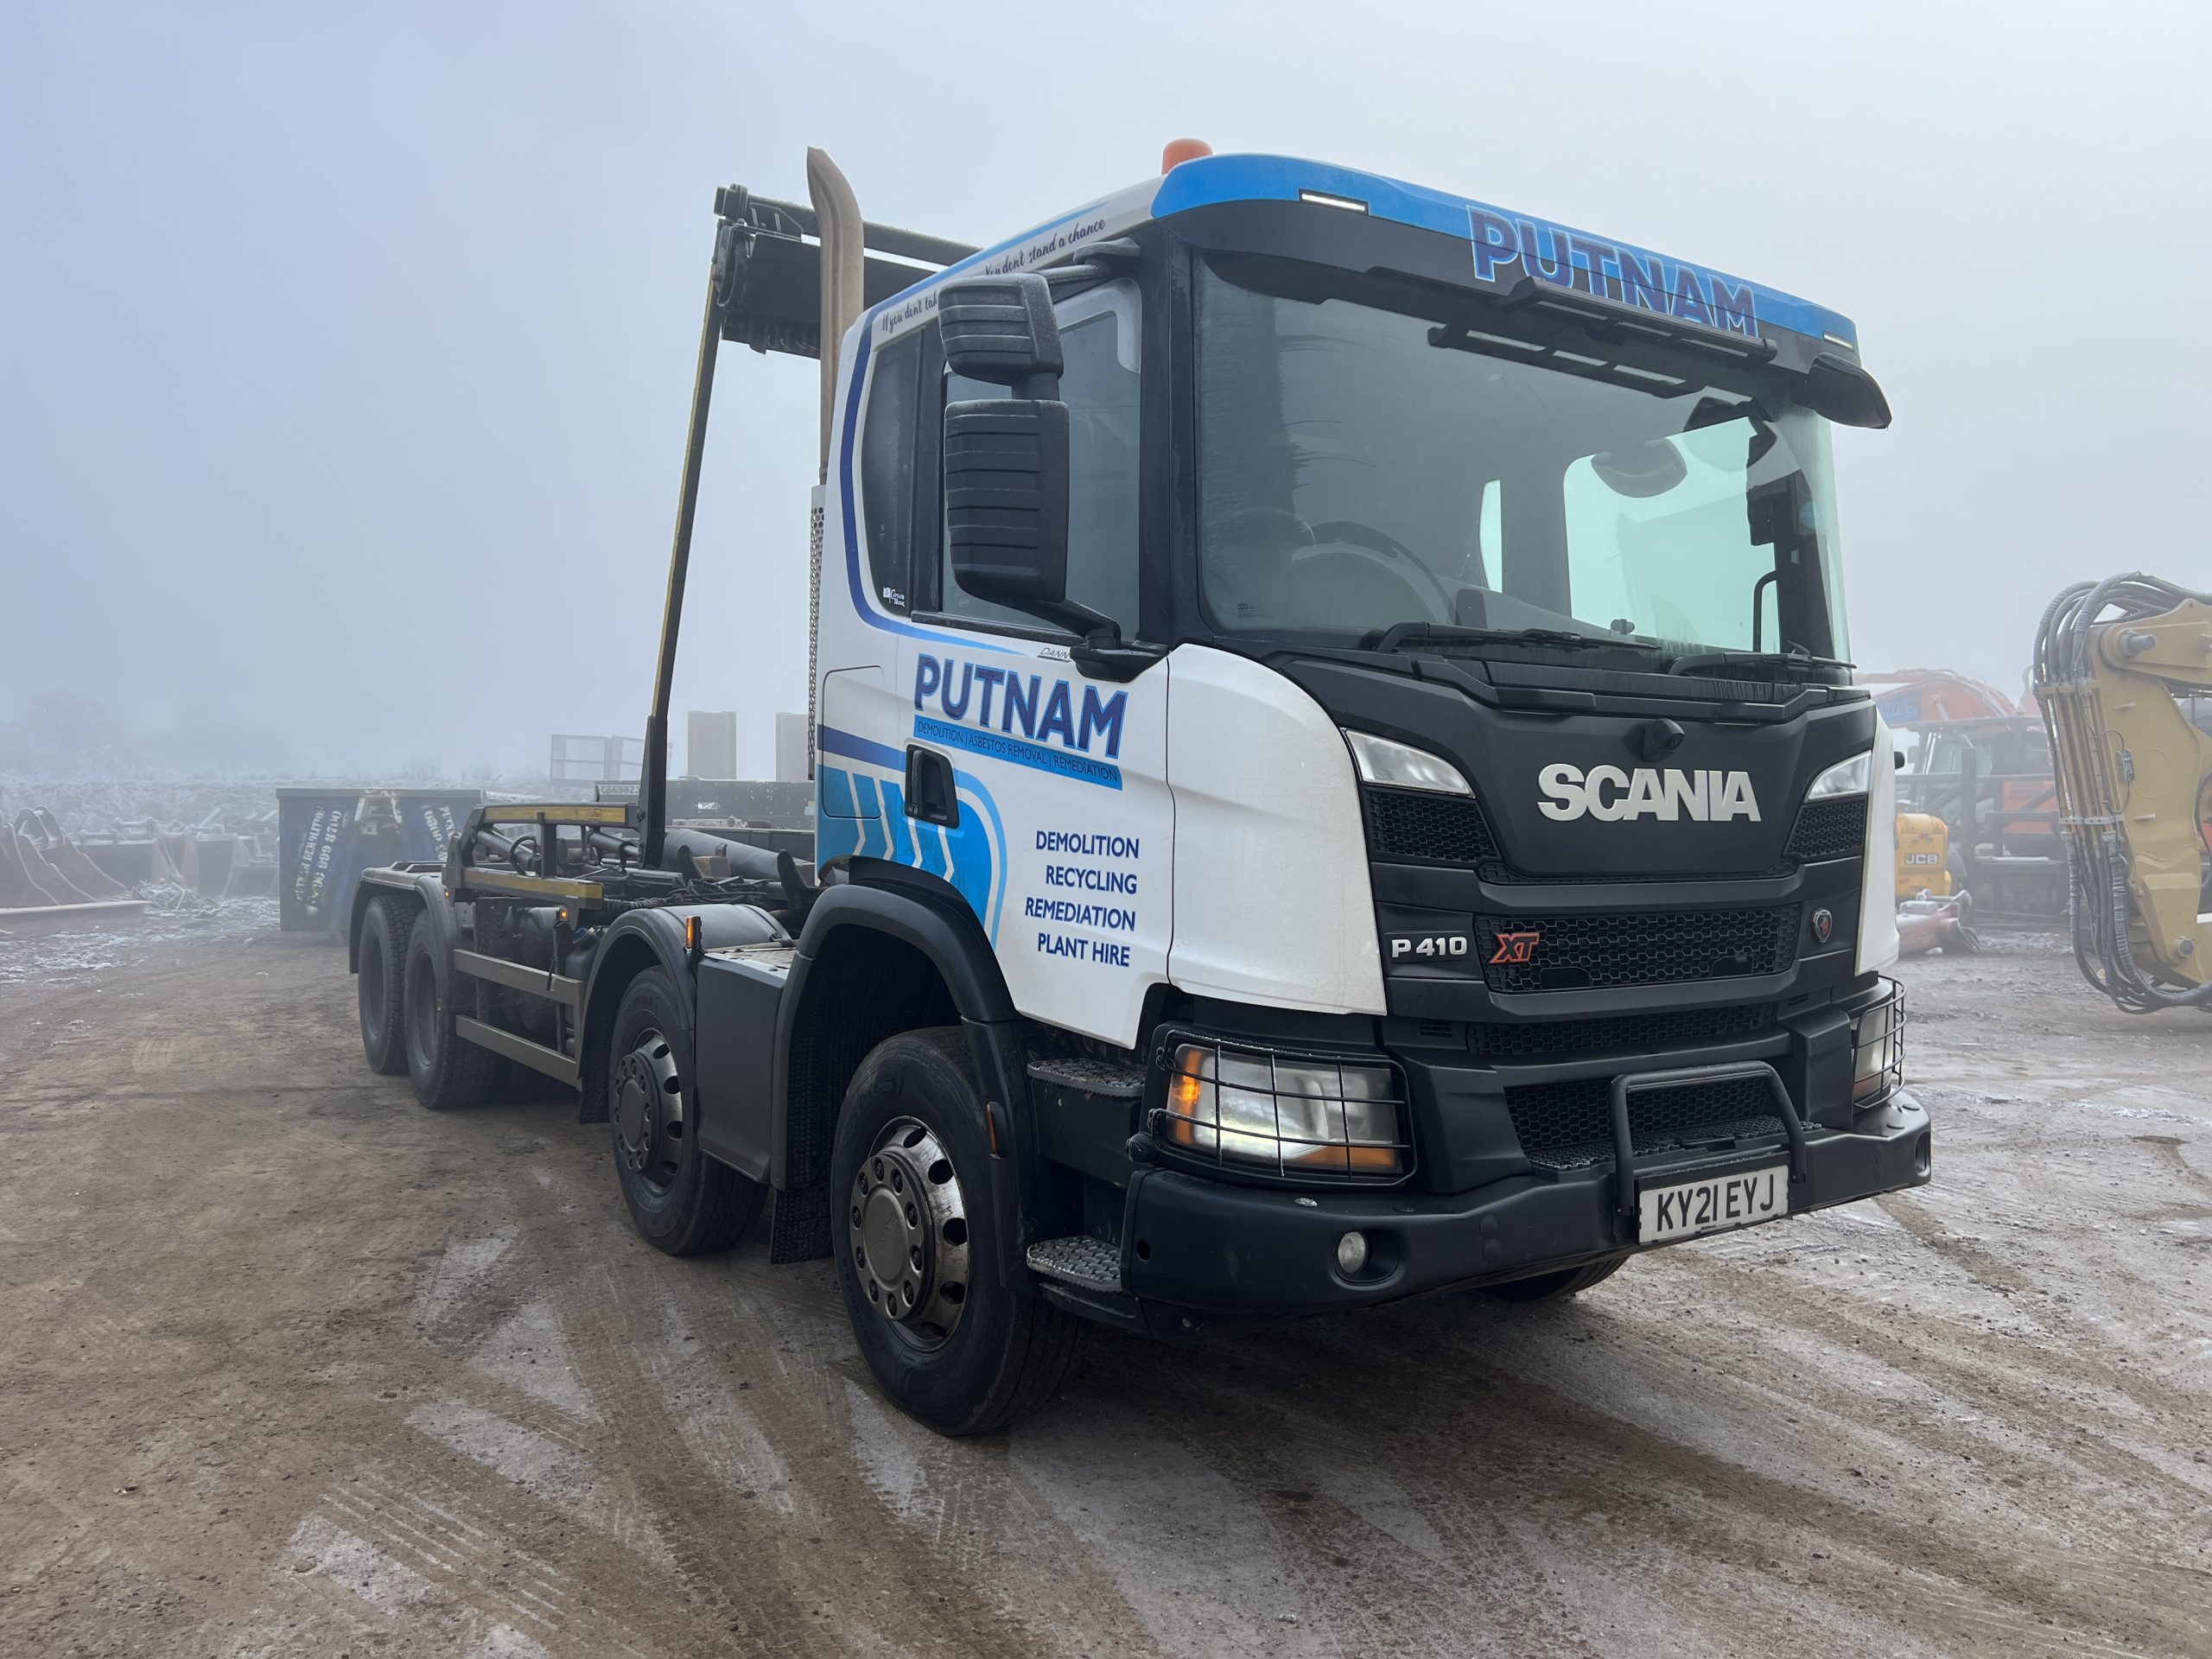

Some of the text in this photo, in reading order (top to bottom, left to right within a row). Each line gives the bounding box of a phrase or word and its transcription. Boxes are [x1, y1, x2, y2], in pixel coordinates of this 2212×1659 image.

[889, 315, 903, 334] you
[925, 290, 938, 310] tak
[1029, 232, 1058, 264] stand
[1058, 238, 1065, 247] a
[1068, 219, 1106, 245] chance
[1465, 206, 1758, 338] PUTNAM
[1039, 647, 1071, 659] DANN
[914, 653, 1128, 759] PUTNAM
[918, 721, 964, 743] DEMOLITION
[969, 736, 1006, 754] ASBESTOS
[1007, 744, 1047, 764] REMOVAL
[1053, 757, 1118, 782] REMEDIATION
[1537, 763, 1762, 823] SCANIA
[1036, 830, 1140, 859] DEMOLITION
[1906, 854, 1939, 865] JCB
[1046, 865, 1137, 894] RECYCLING
[1025, 897, 1136, 932] REMEDIATION
[1038, 932, 1131, 968] PLANT HIRE
[1391, 936, 1468, 958] P 410
[1490, 931, 1541, 964] XT
[1657, 1174, 1774, 1232] KY21 EYJ
